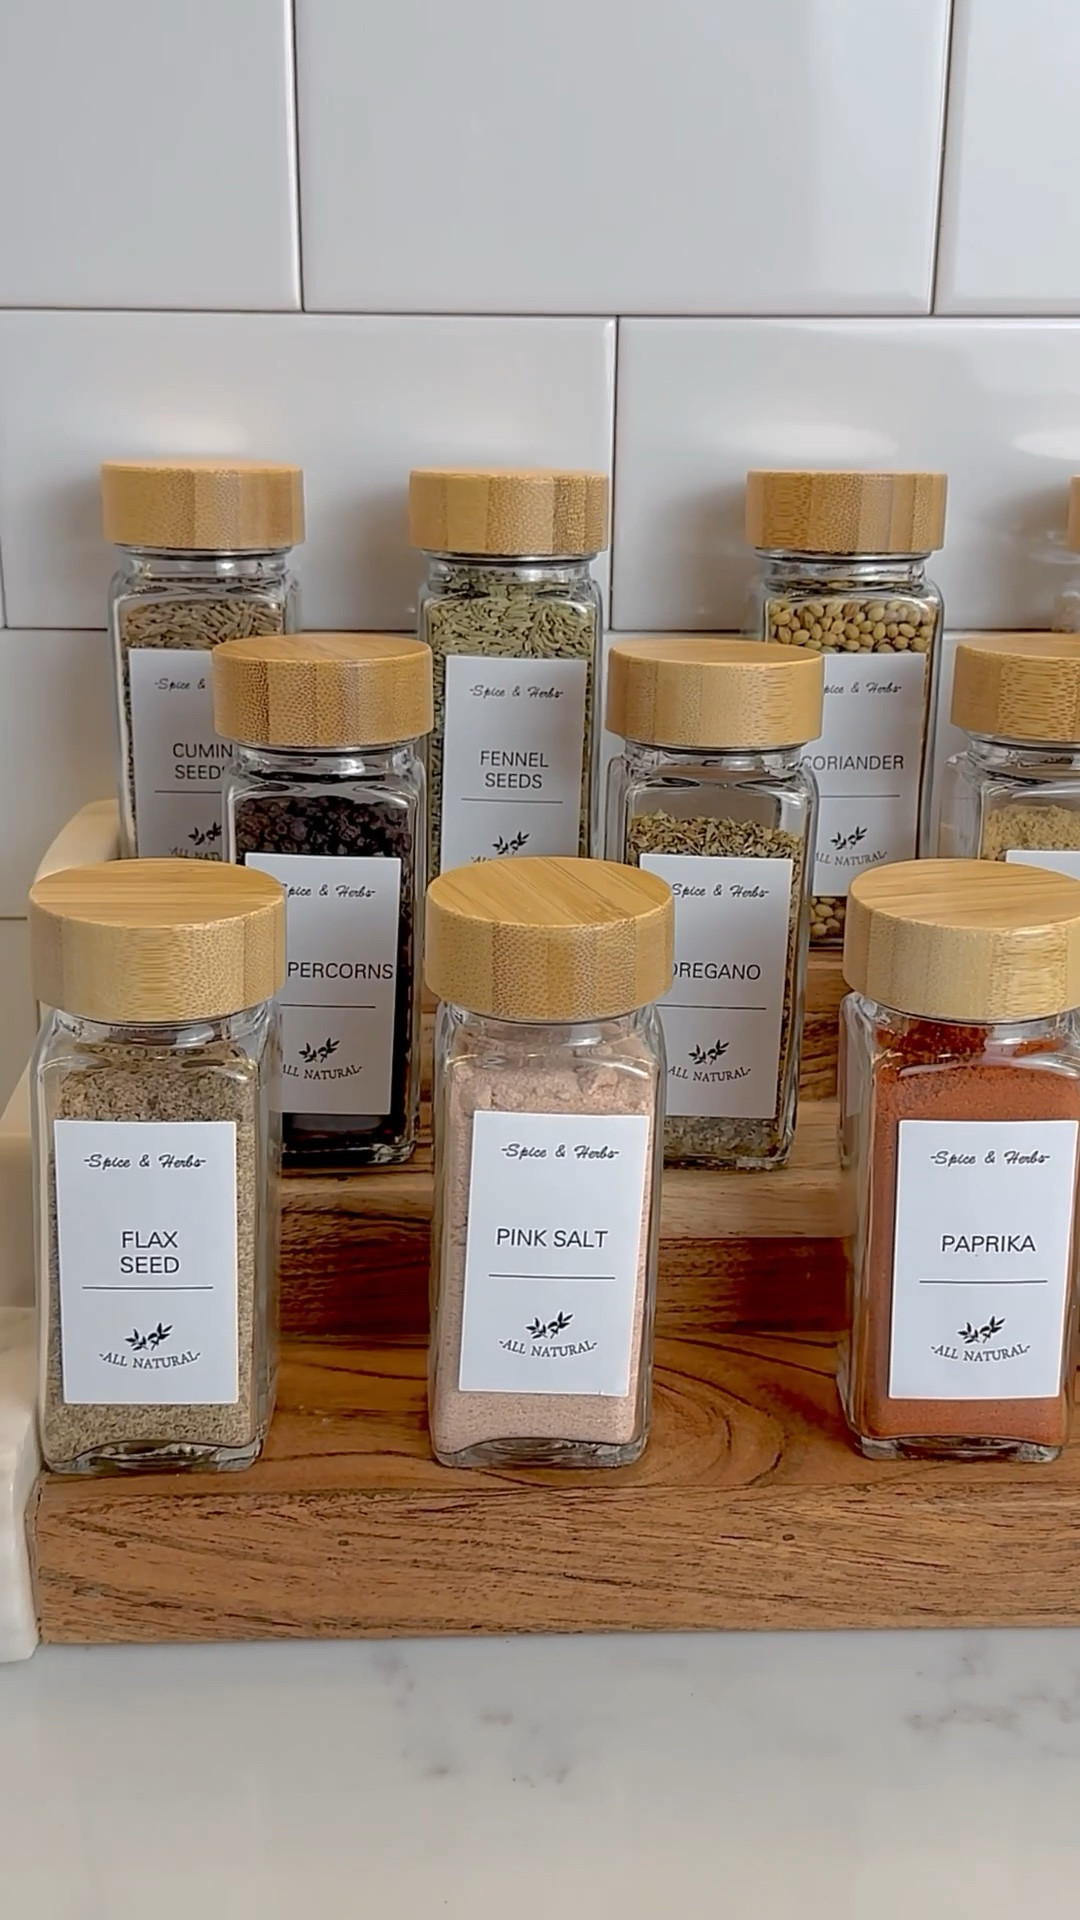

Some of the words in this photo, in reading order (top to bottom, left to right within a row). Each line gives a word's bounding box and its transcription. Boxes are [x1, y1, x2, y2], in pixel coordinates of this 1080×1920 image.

[197, 678, 206, 690] &
[511, 685, 521, 697] &
[824, 684, 845, 695] pice
[850, 681, 860, 694] &
[172, 742, 233, 759] CUMIN
[480, 750, 550, 768] FENNEL
[174, 764, 226, 780] SEED
[484, 772, 543, 790] SEEDS
[282, 883, 312, 898] pice
[318, 883, 329, 897] &
[712, 883, 723, 897] &
[286, 960, 394, 980] PERCORNS
[554, 1144, 566, 1158] &
[984, 1150, 996, 1165] &
[138, 1153, 150, 1168] &
[121, 1230, 179, 1249] FLAX
[496, 1227, 548, 1248] PINK
[553, 1229, 609, 1249] SALT
[941, 1234, 1037, 1253] PAPRIKA
[120, 1255, 180, 1274] SEED
